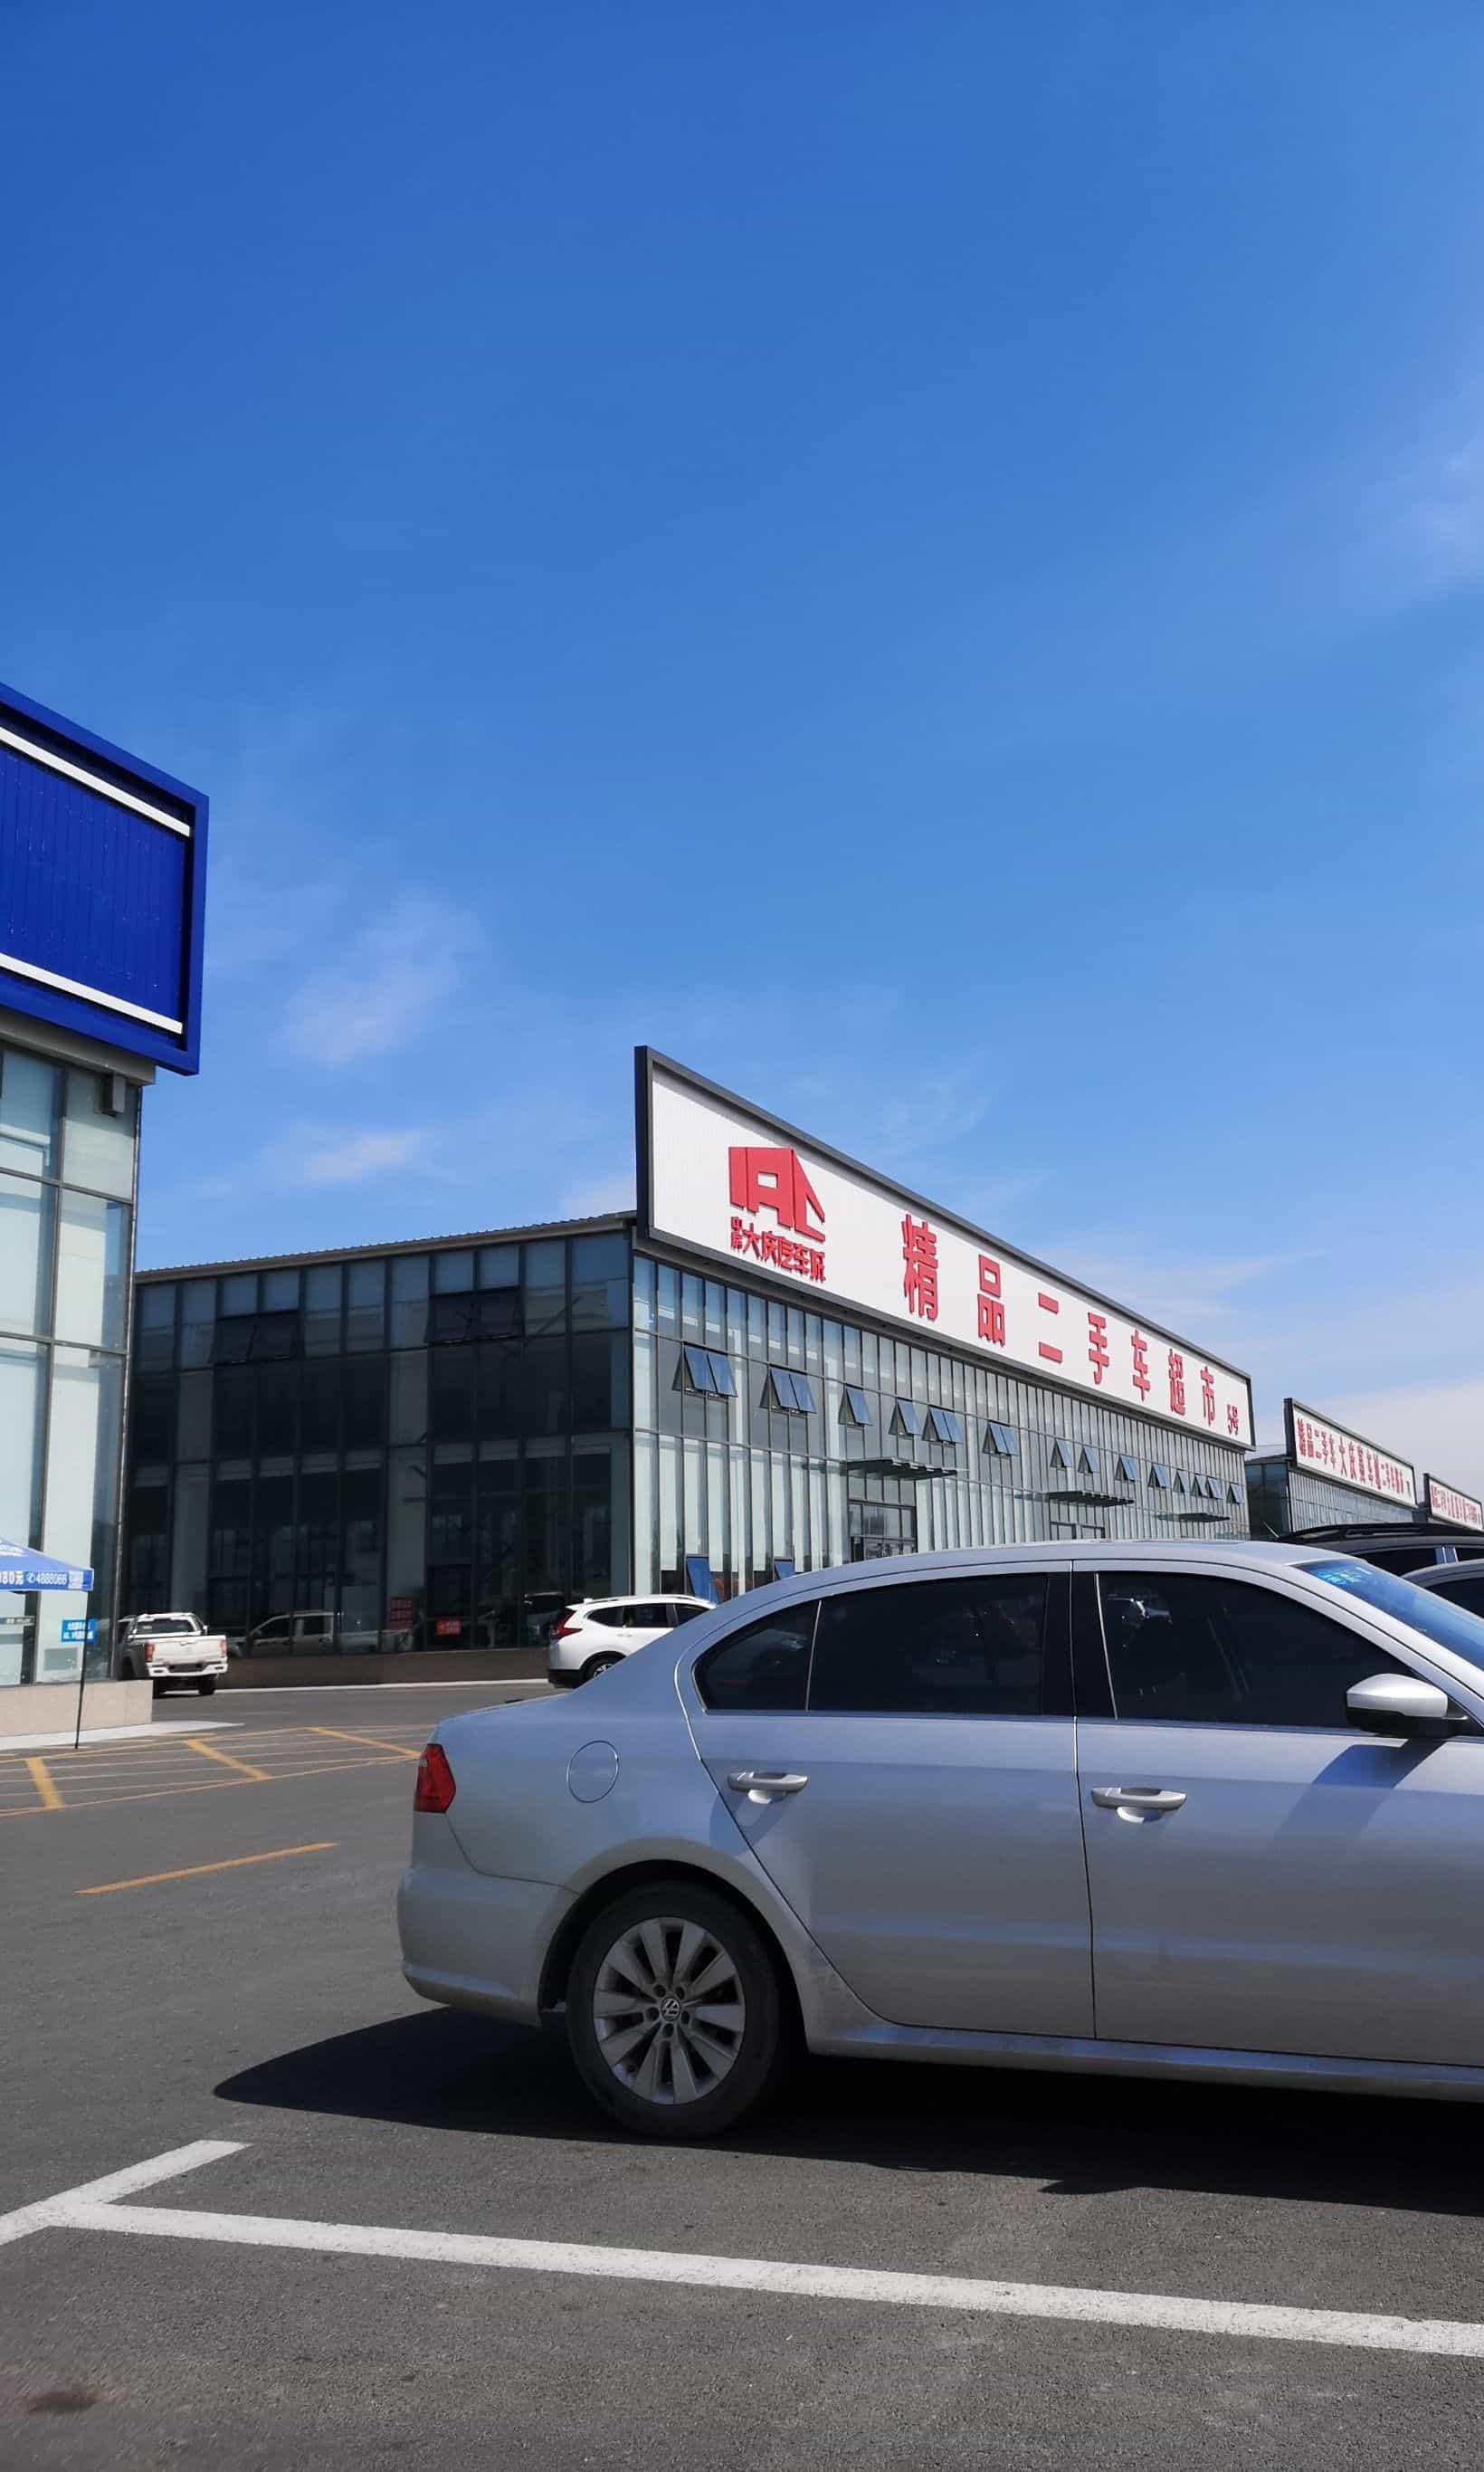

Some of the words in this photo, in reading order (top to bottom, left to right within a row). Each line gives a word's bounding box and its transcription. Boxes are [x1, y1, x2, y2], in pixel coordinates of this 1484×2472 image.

[901, 1214, 1216, 1427] 精品二手车超市
[0, 1571, 24, 1585] 80元
